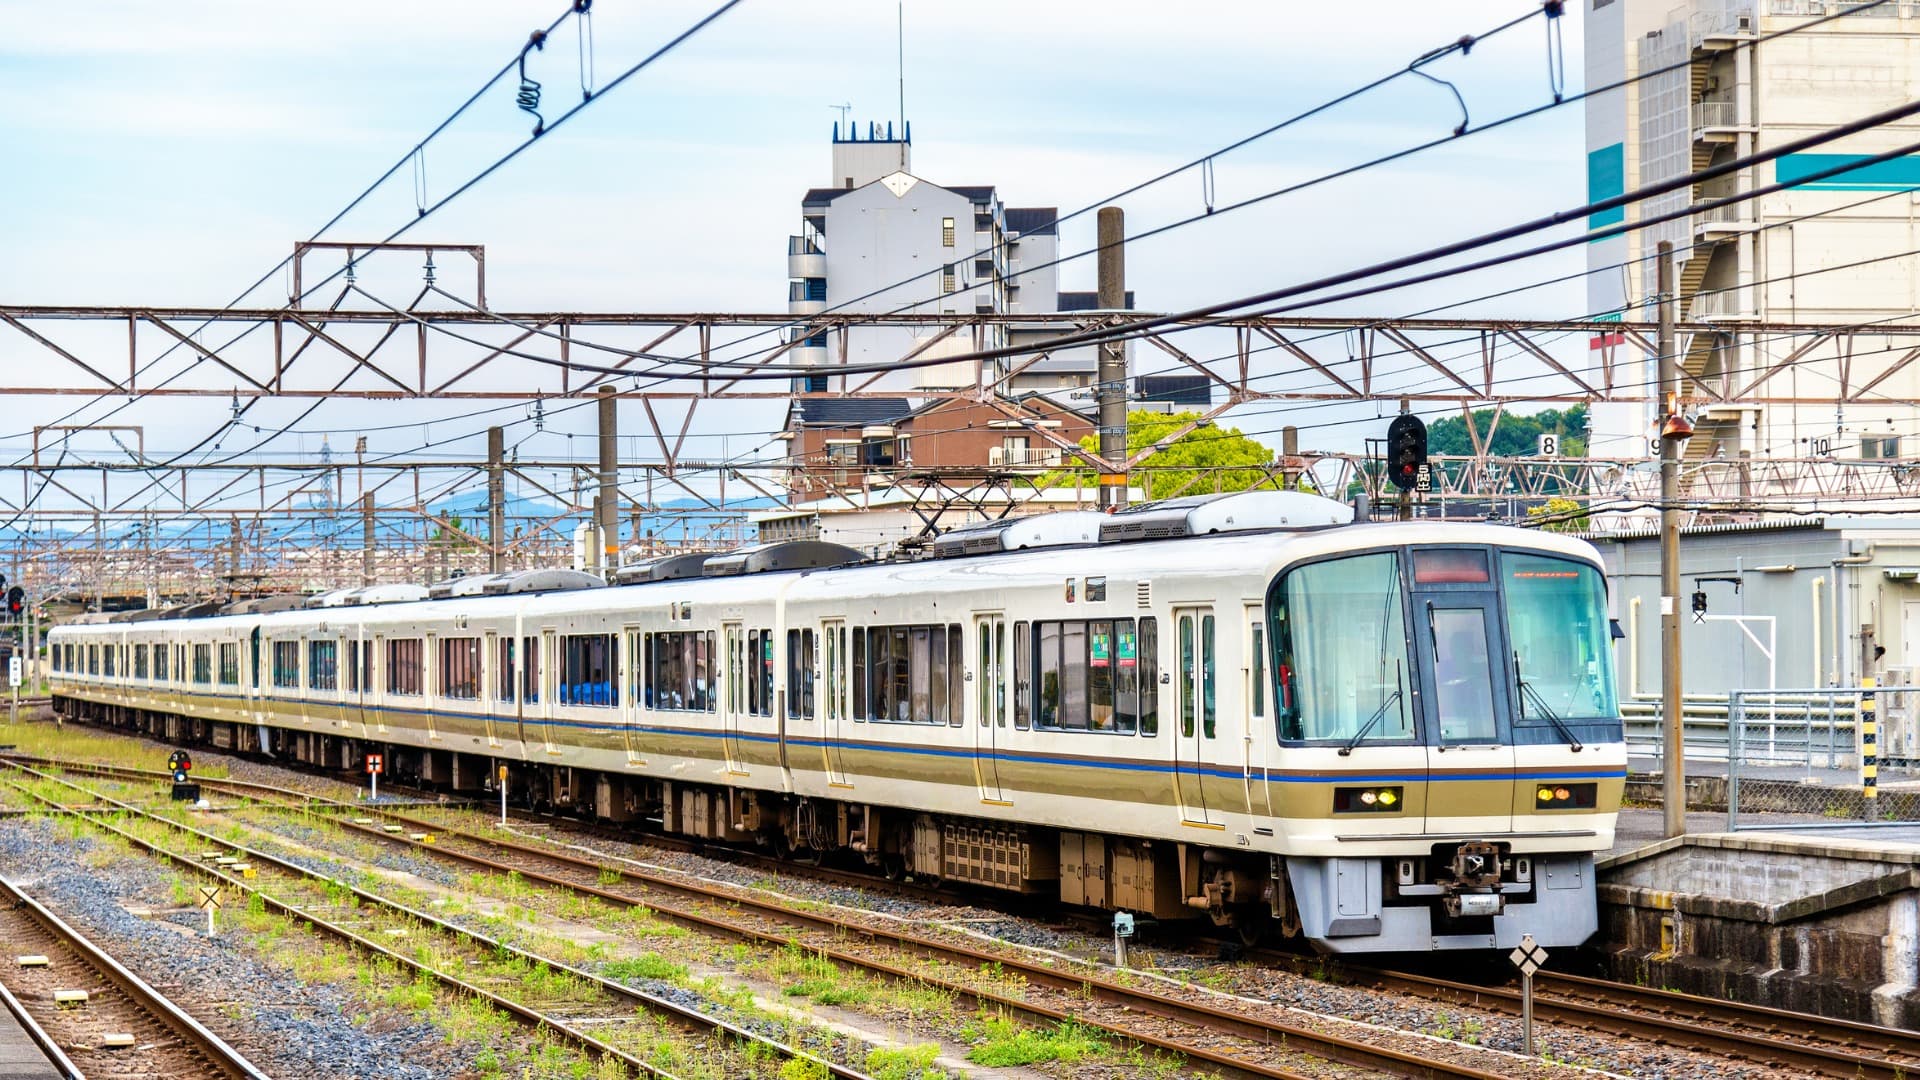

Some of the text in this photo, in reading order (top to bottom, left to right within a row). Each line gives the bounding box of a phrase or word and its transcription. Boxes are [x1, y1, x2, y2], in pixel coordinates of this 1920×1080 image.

[1544, 437, 1555, 454] 8
[1650, 439, 1661, 456] 9
[1814, 439, 1828, 456] 10
